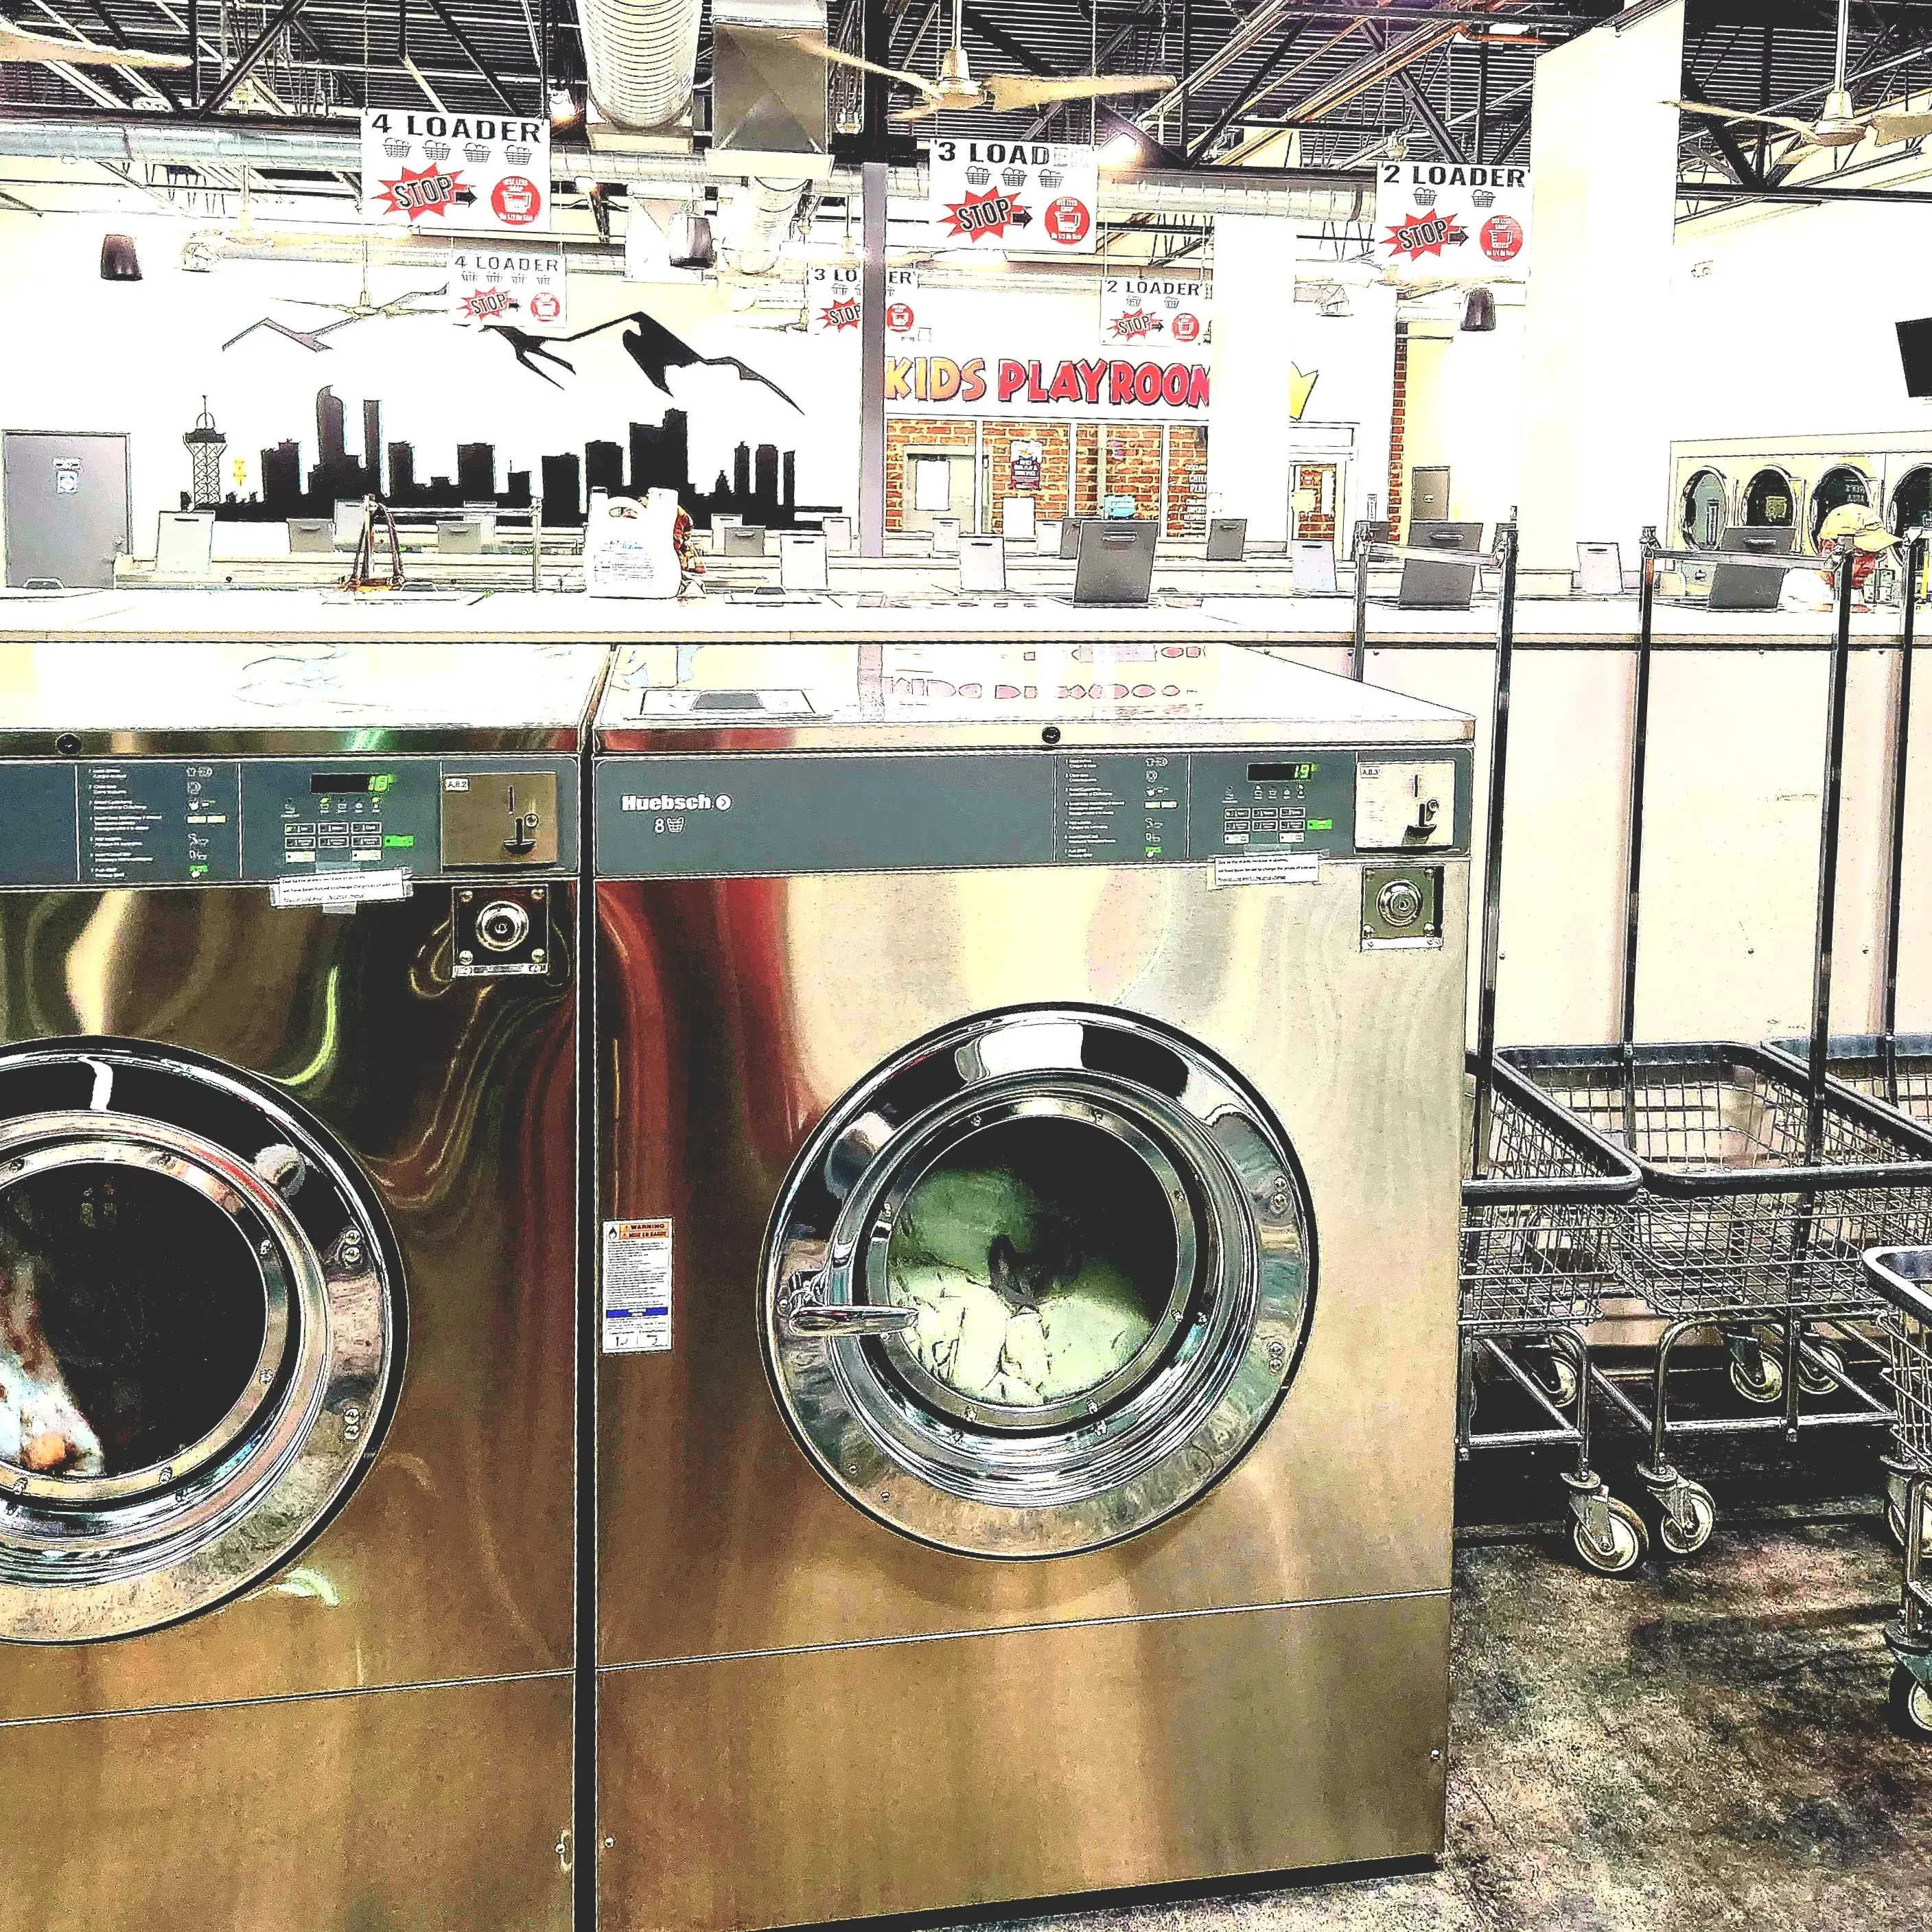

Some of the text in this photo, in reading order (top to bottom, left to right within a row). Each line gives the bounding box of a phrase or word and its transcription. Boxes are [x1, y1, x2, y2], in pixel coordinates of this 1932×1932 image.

[371, 113, 542, 143] 4 LOADER
[938, 141, 956, 162] 3
[1384, 165, 1526, 188] 2 LOADER
[393, 176, 454, 209] STOP
[957, 198, 1010, 231] STOP
[1398, 219, 1447, 250] STOP
[454, 256, 558, 272] 4 LOADER
[814, 268, 826, 281] 3
[1107, 280, 1200, 296] 2 LOADER
[470, 294, 507, 314] STOP
[1118, 316, 1150, 334] STOP
[884, 356, 987, 402] KIDS
[1294, 764, 1310, 779] 19
[621, 793, 712, 812] Huebsch
[654, 817, 666, 834] 8
